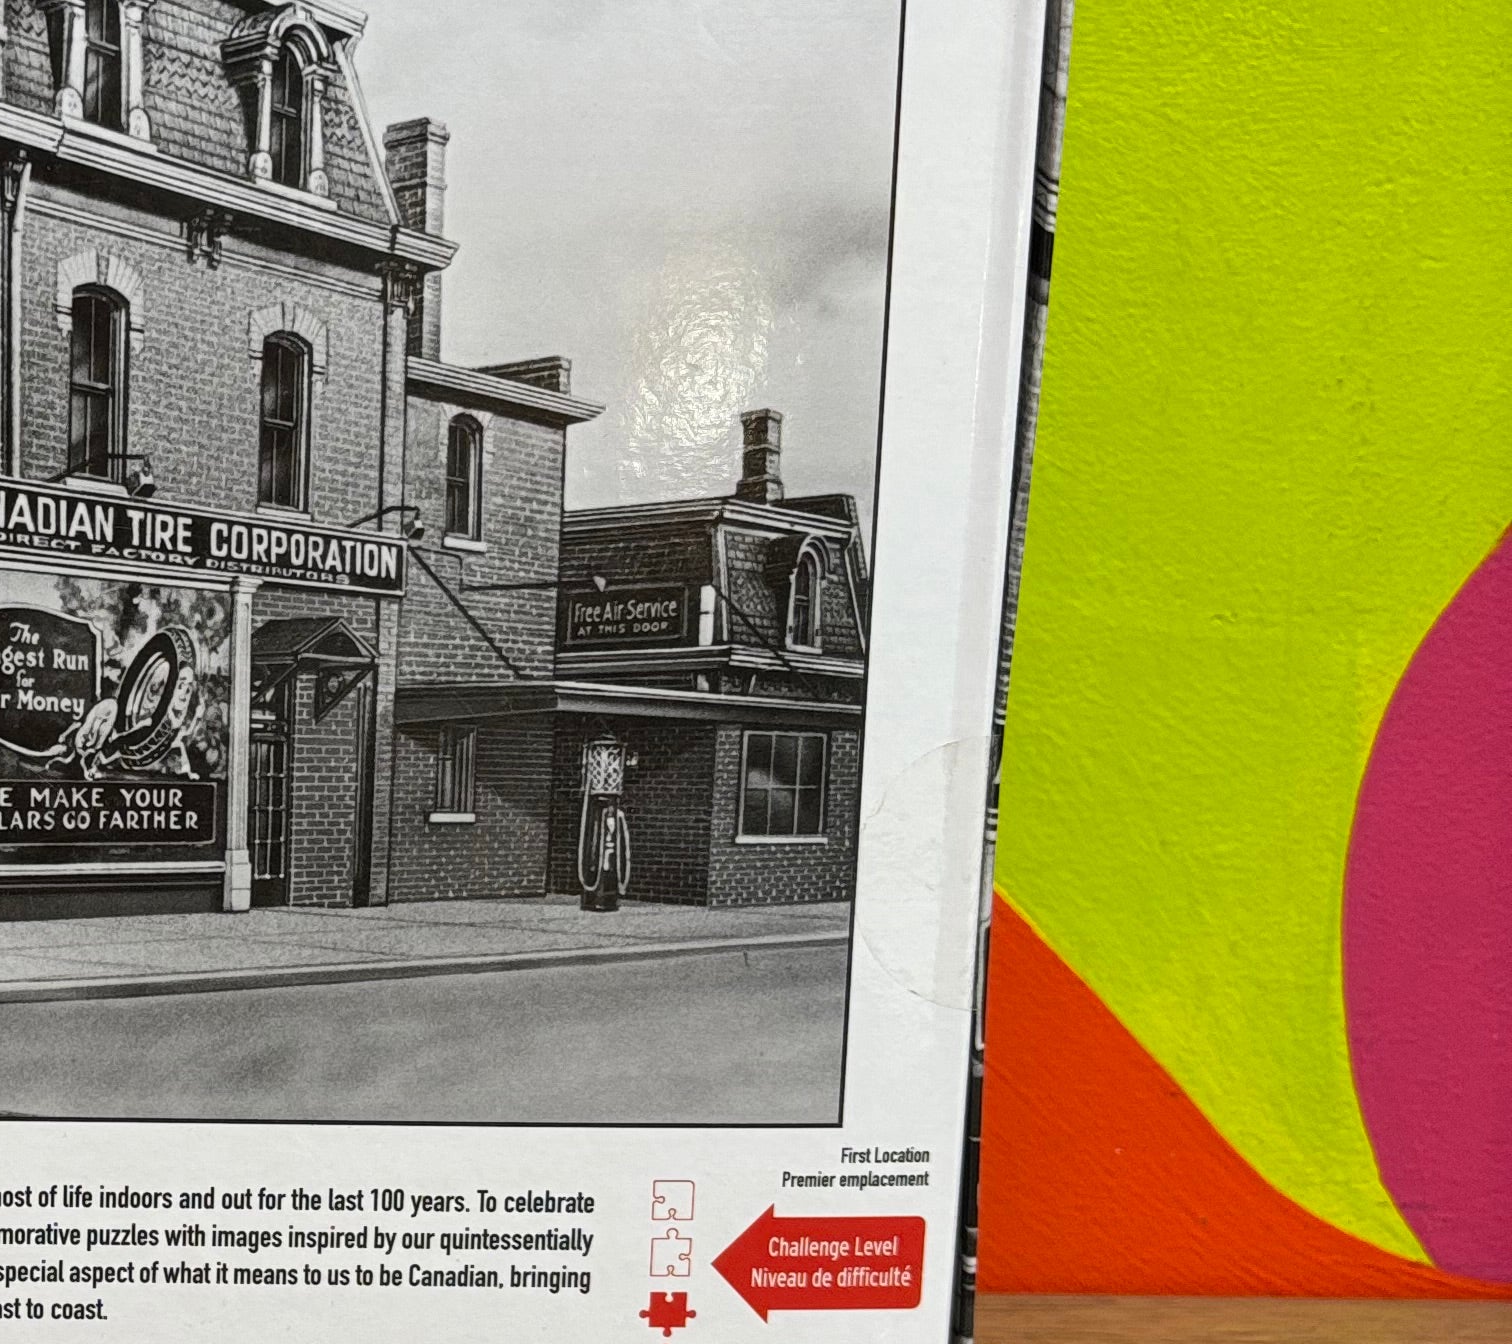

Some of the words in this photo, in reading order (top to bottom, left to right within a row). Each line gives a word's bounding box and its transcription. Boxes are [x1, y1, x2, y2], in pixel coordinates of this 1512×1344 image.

[126, 510, 193, 555] TIRE
[209, 522, 398, 581] CORPORATION
[90, 543, 200, 567] FACTORY
[205, 558, 351, 586] DISTRIBUTORS
[8, 621, 41, 646] The
[577, 626, 592, 636] AT
[598, 623, 626, 634] THIS
[52, 649, 89, 671] Run
[15, 670, 36, 688] for
[15, 688, 86, 719] Money
[30, 786, 104, 808] MAKE
[120, 788, 183, 808] YOUR
[62, 810, 90, 831] GO
[99, 810, 199, 831] FARTHER
[841, 1147, 871, 1164] First
[875, 1147, 930, 1164] Location
[782, 1172, 836, 1188] Premier
[839, 1172, 929, 1190] emplacement
[39, 1185, 57, 1207] of
[63, 1185, 92, 1207] life
[100, 1185, 172, 1208] indoors
[180, 1187, 214, 1209] and
[222, 1189, 252, 1209] out
[258, 1187, 286, 1210] for
[291, 1188, 321, 1210] the
[329, 1188, 364, 1211] last
[371, 1189, 404, 1211] 100
[411, 1195, 469, 1217] years.
[477, 1190, 496, 1212] To
[505, 1190, 594, 1213] celebrate
[768, 1236, 849, 1258] Challenge
[854, 1236, 898, 1256] Level
[751, 1268, 806, 1288] Niveau
[811, 1268, 832, 1288] de
[837, 1265, 911, 1288] difficulté
[26, 1298, 43, 1319] to
[51, 1299, 107, 1320] coast.
